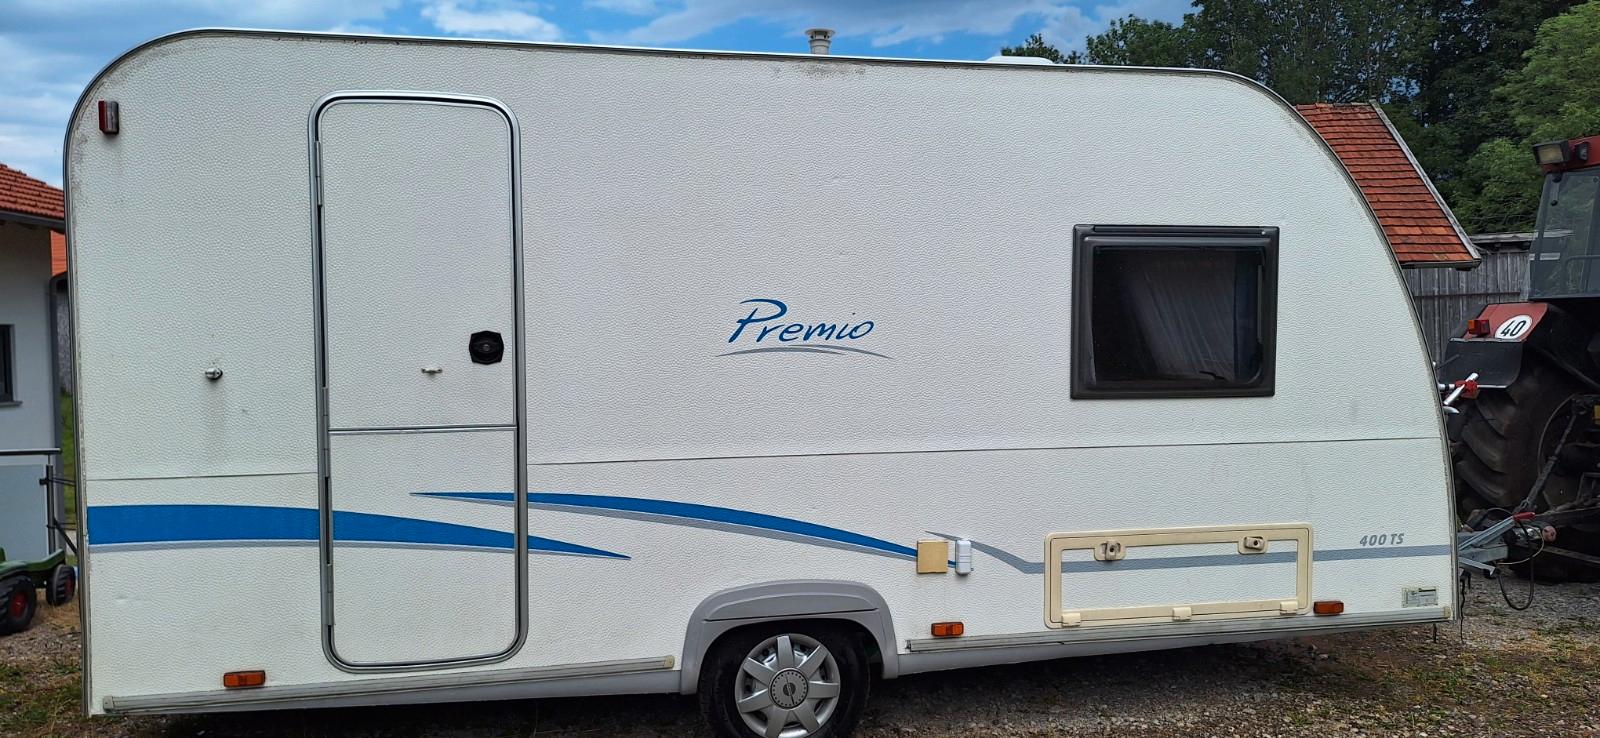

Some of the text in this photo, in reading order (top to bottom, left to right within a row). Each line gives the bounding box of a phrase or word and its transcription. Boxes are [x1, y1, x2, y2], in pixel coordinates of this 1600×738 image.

[728, 298, 875, 343] Premio
[1500, 319, 1527, 338] 40
[1359, 533, 1405, 546] 400 TS
